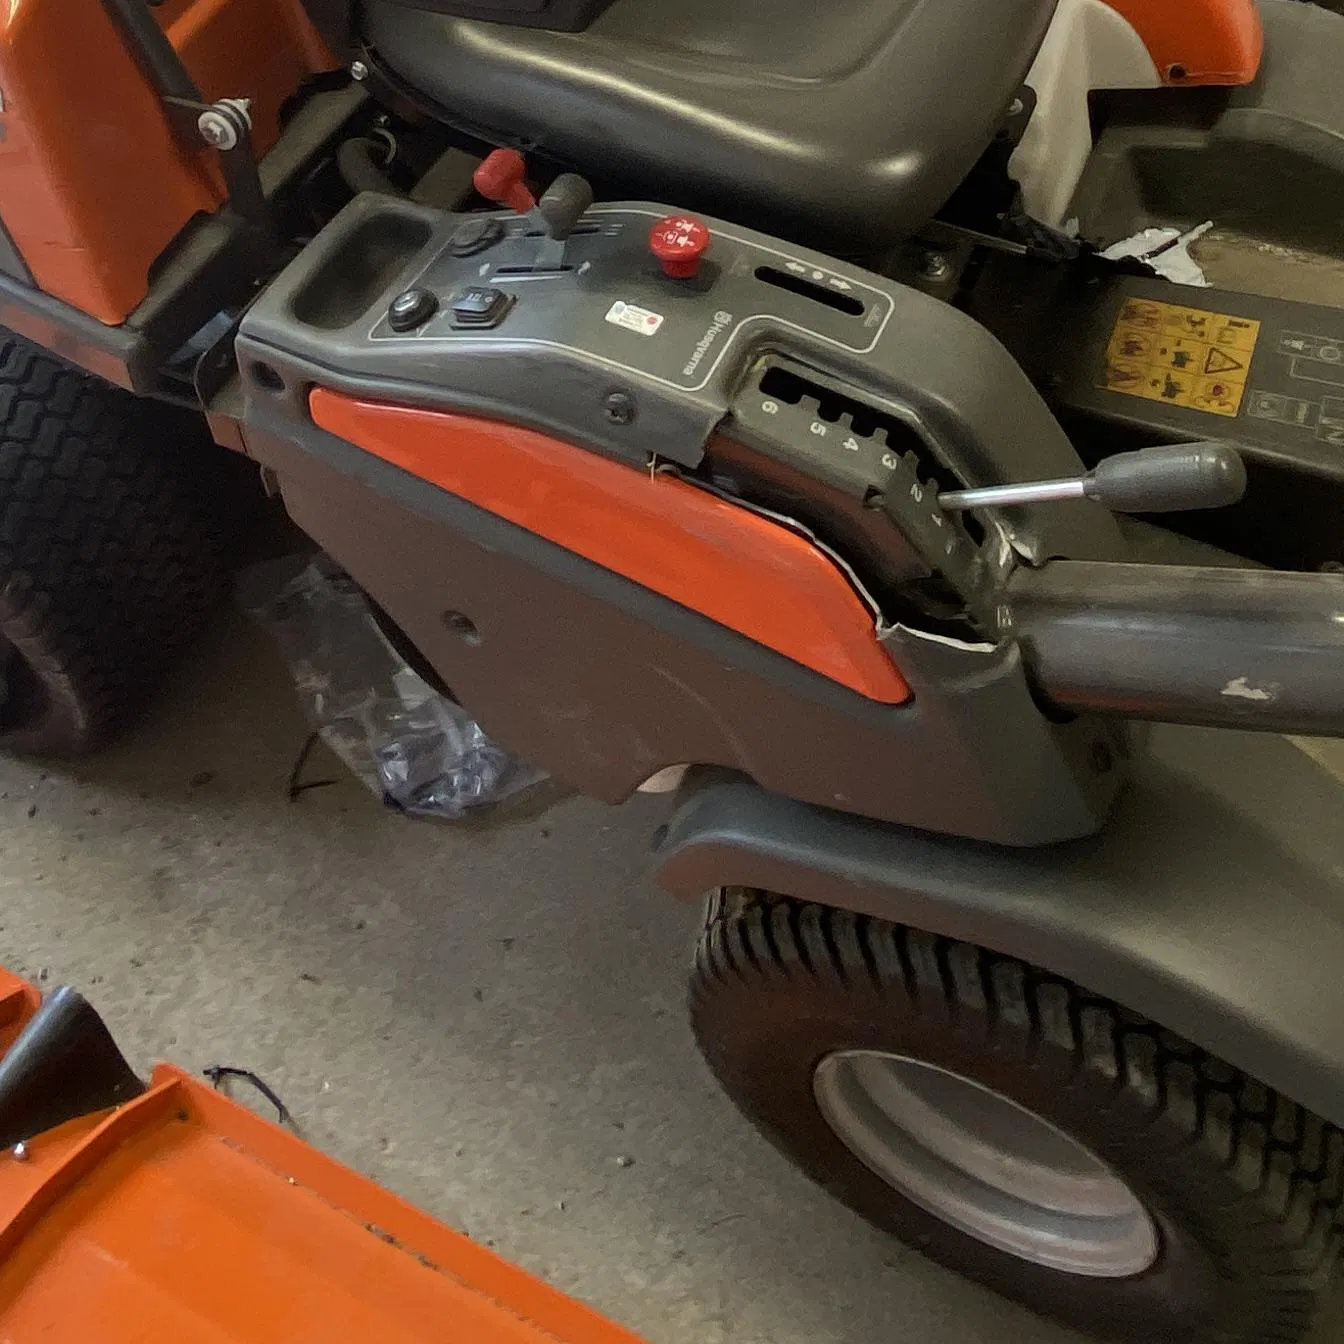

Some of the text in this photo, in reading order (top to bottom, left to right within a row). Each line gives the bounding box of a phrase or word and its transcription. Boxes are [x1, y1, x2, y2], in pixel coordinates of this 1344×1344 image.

[682, 319, 729, 376] Husqvarna
[762, 400, 778, 414] 6
[810, 422, 826, 436] 5
[842, 438, 859, 451] 4
[882, 454, 897, 470] 3
[910, 483, 922, 503] 2
